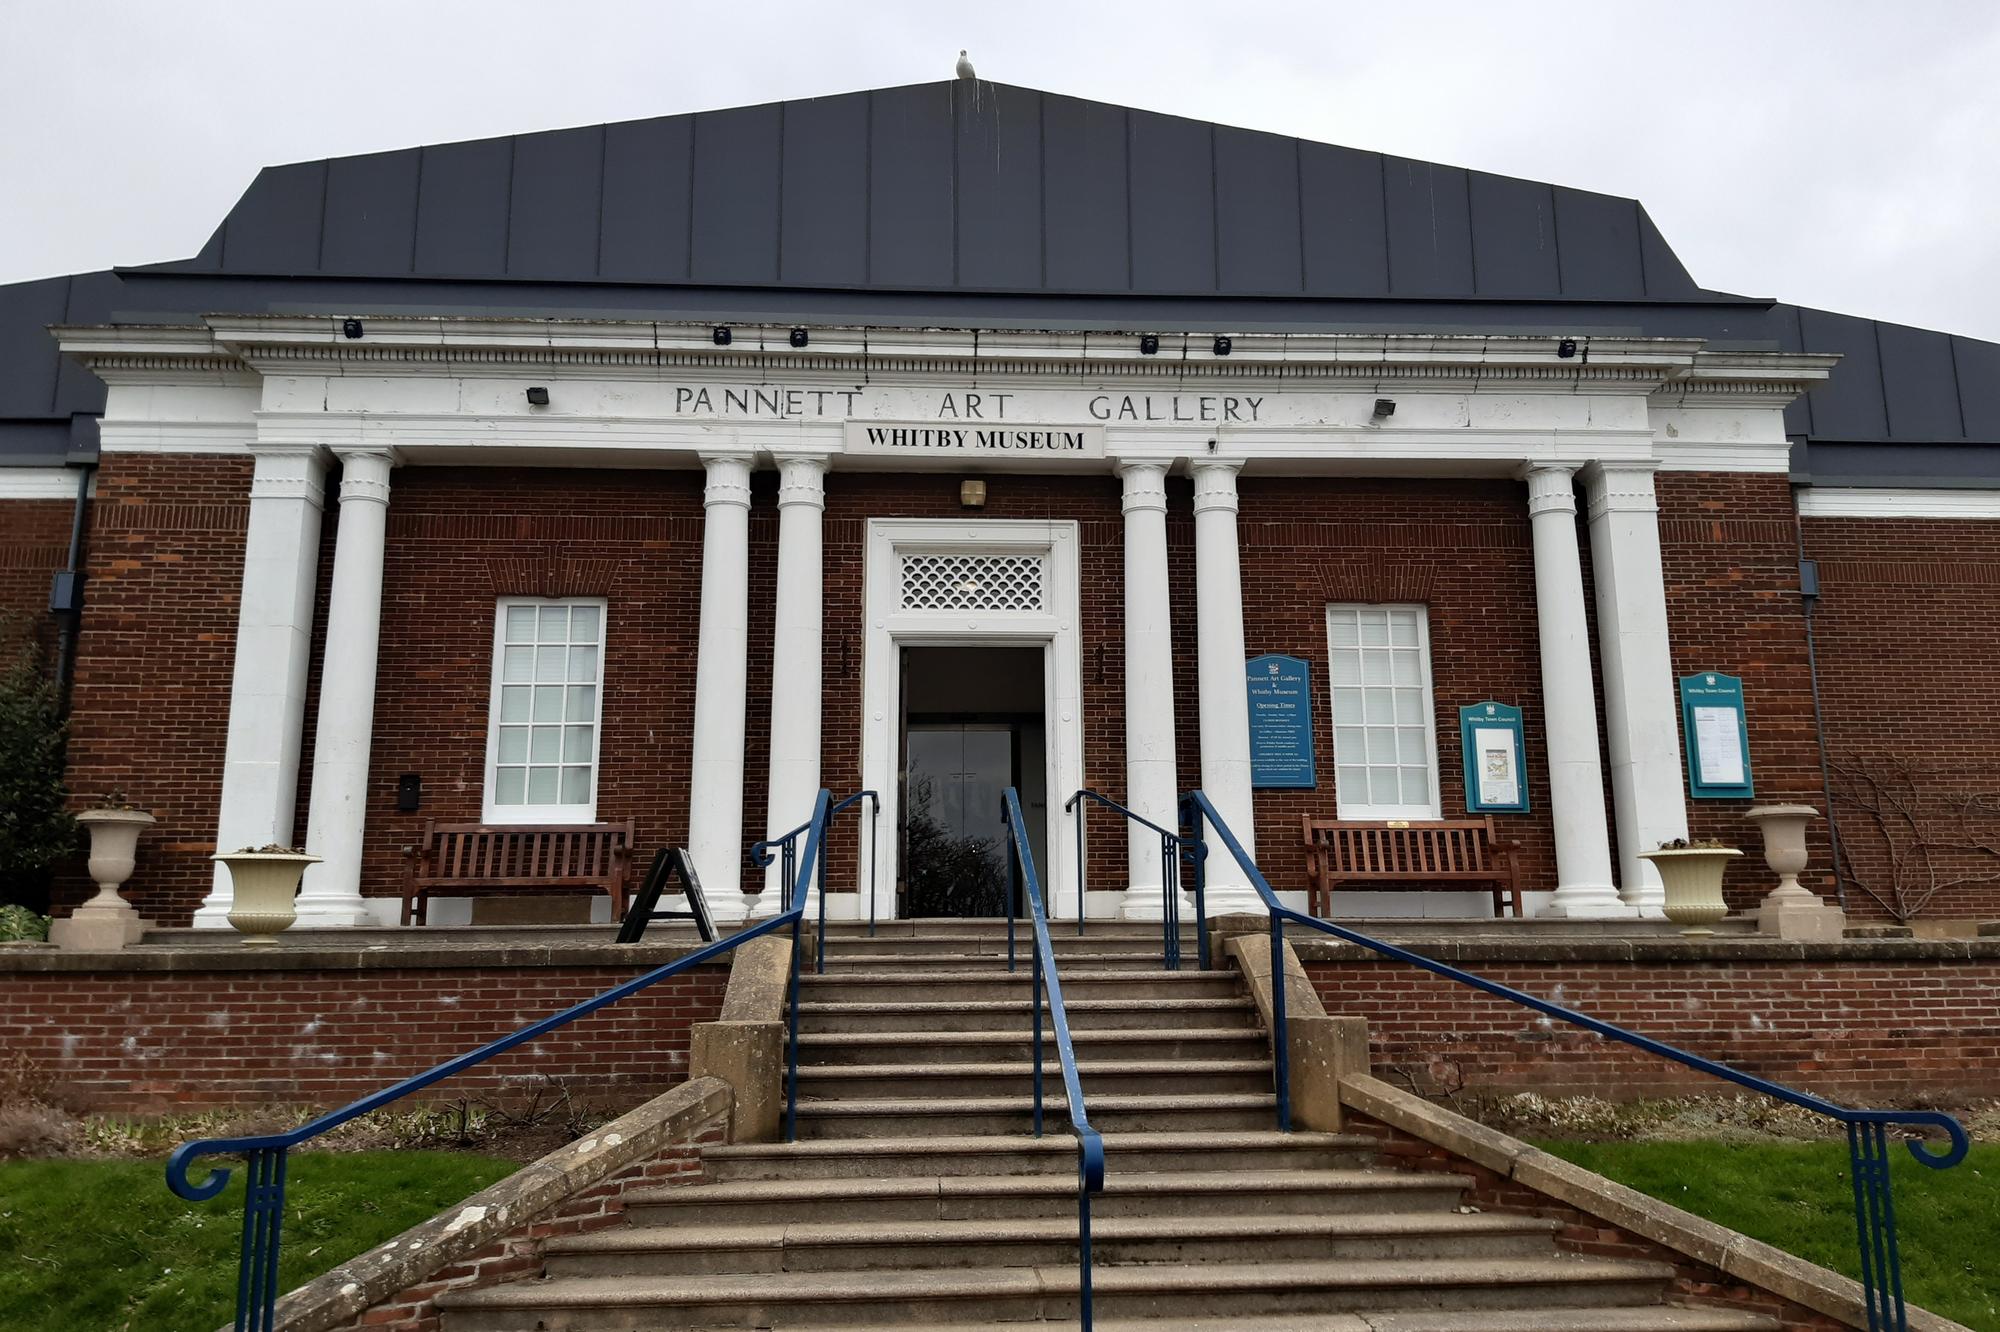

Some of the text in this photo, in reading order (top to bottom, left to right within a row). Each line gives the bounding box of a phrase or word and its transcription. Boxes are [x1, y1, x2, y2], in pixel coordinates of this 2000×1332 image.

[675, 387, 1265, 422] PANNETT ART GALLERY
[866, 427, 1085, 450] WHITBY MUSEUM
[1280, 675, 1301, 683] Gallery
[1251, 688, 1272, 696] Whitby
